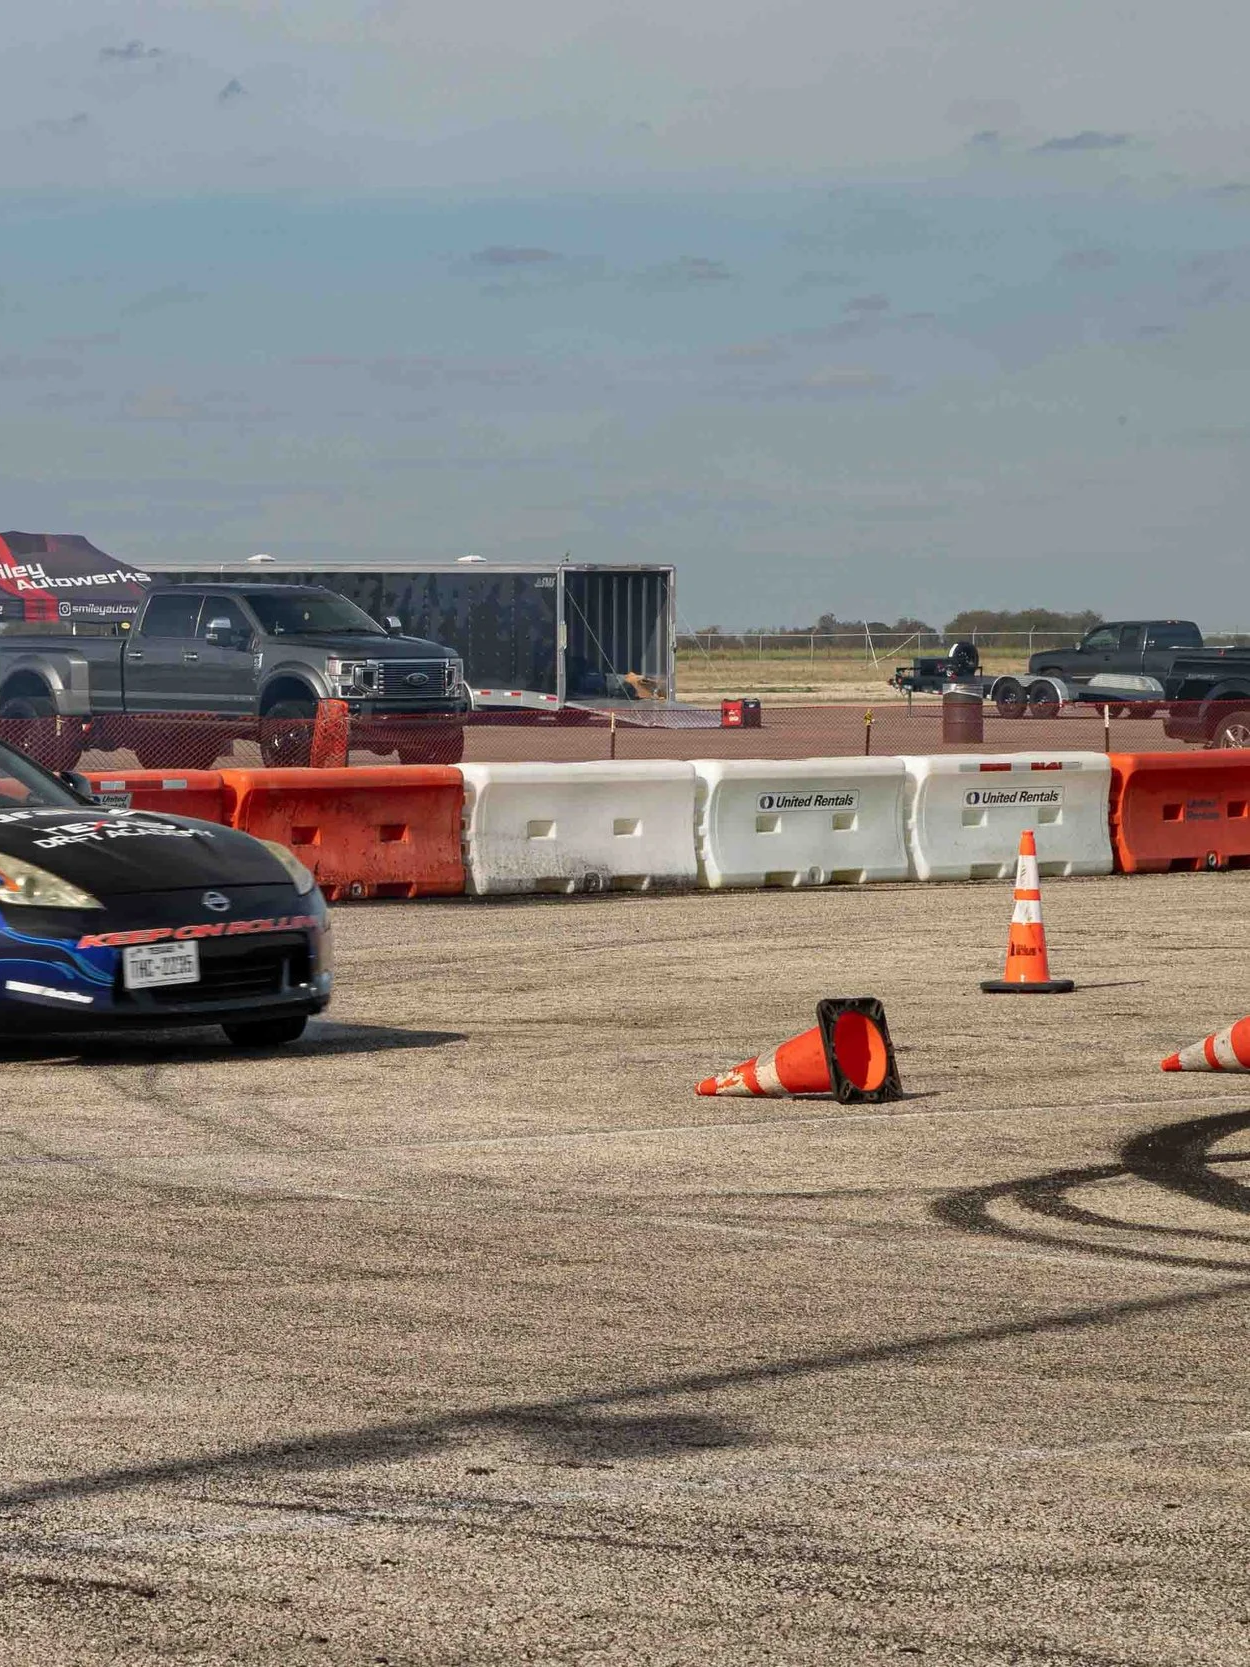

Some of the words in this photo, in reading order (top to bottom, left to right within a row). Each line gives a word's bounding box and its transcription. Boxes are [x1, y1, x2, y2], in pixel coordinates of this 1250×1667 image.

[16, 571, 152, 592] Autowerks
[776, 795, 812, 808] United
[815, 792, 854, 807] Rentals
[982, 791, 1018, 804] United
[1021, 789, 1059, 803] Rentals
[77, 928, 172, 949] KEEP
[174, 922, 228, 940] ON
